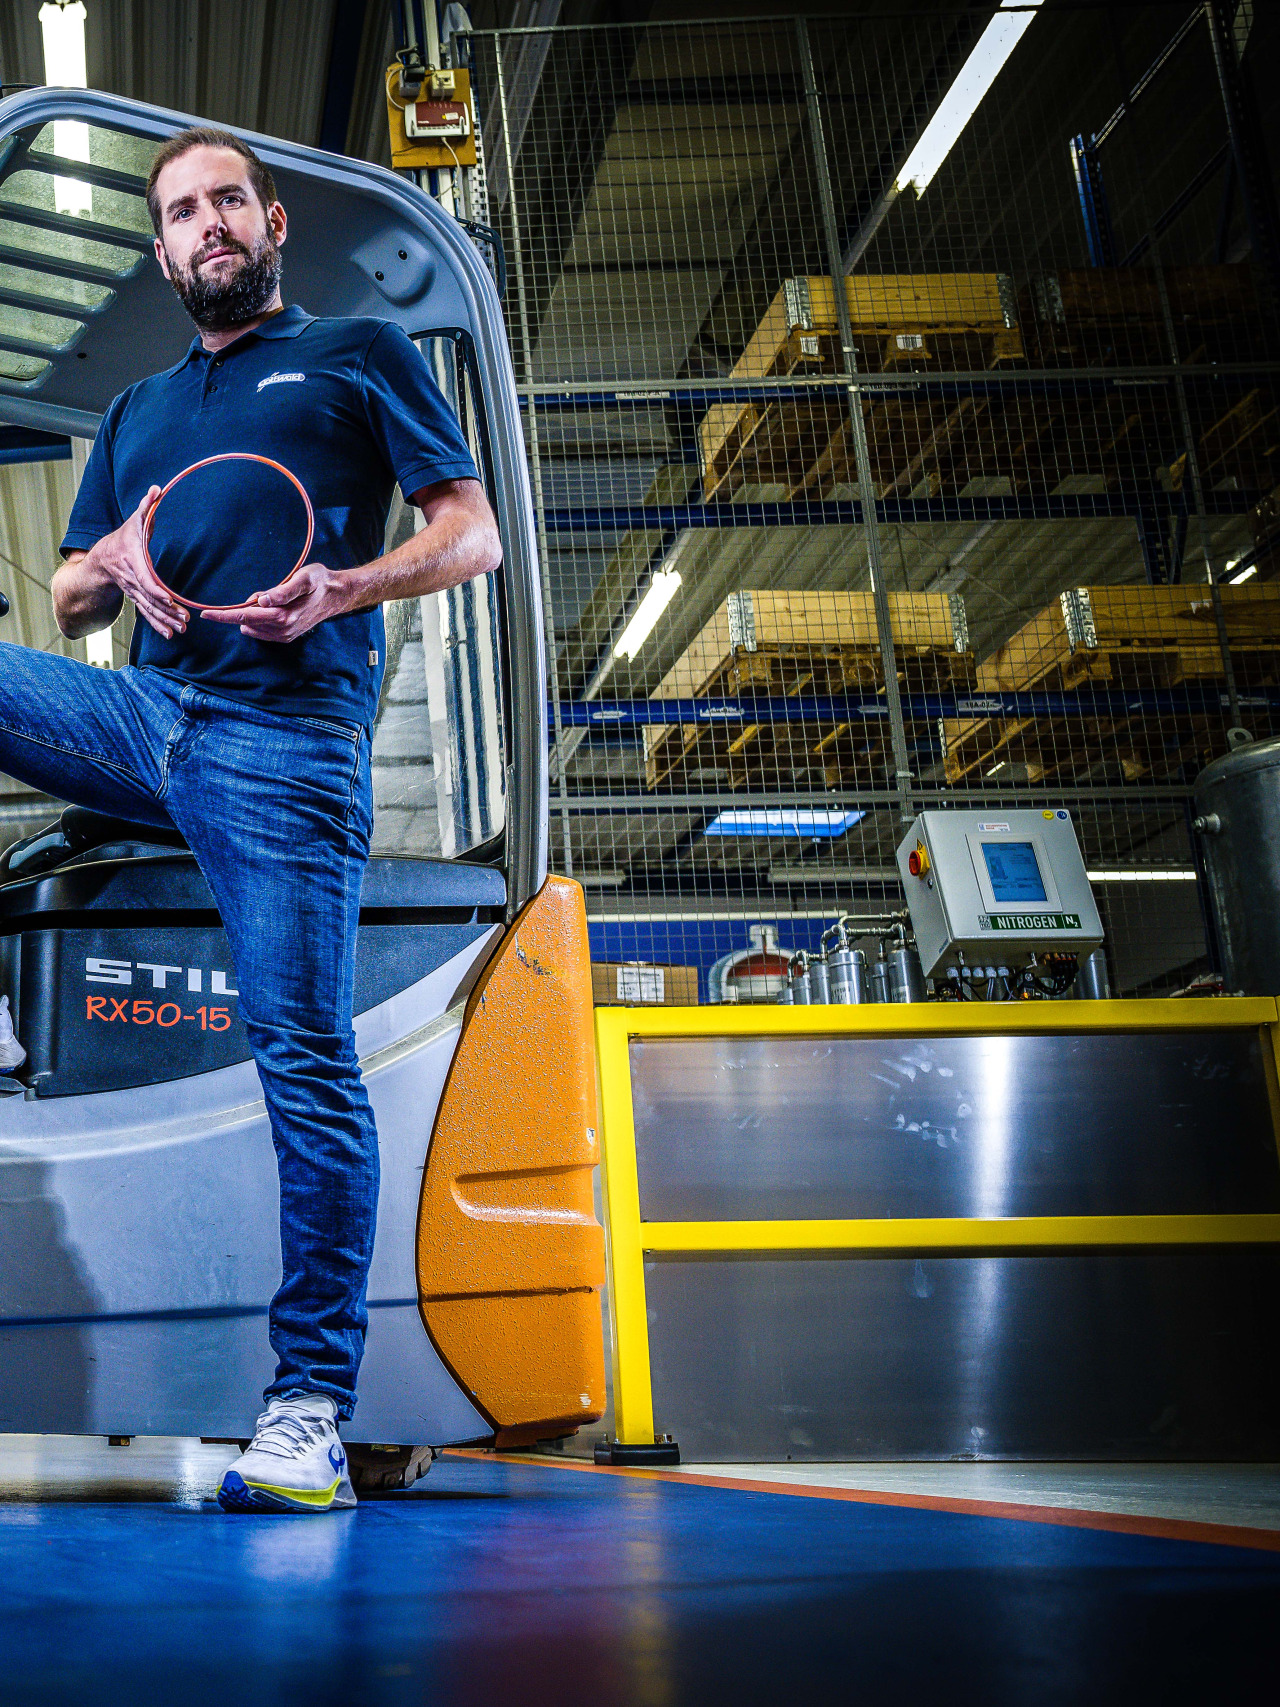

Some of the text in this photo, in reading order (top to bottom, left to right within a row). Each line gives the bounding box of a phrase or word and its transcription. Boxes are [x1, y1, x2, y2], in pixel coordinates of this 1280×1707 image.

[996, 915, 1058, 929] NITROGEN
[85, 957, 240, 996] STIL
[86, 995, 231, 1031] RX50-15
